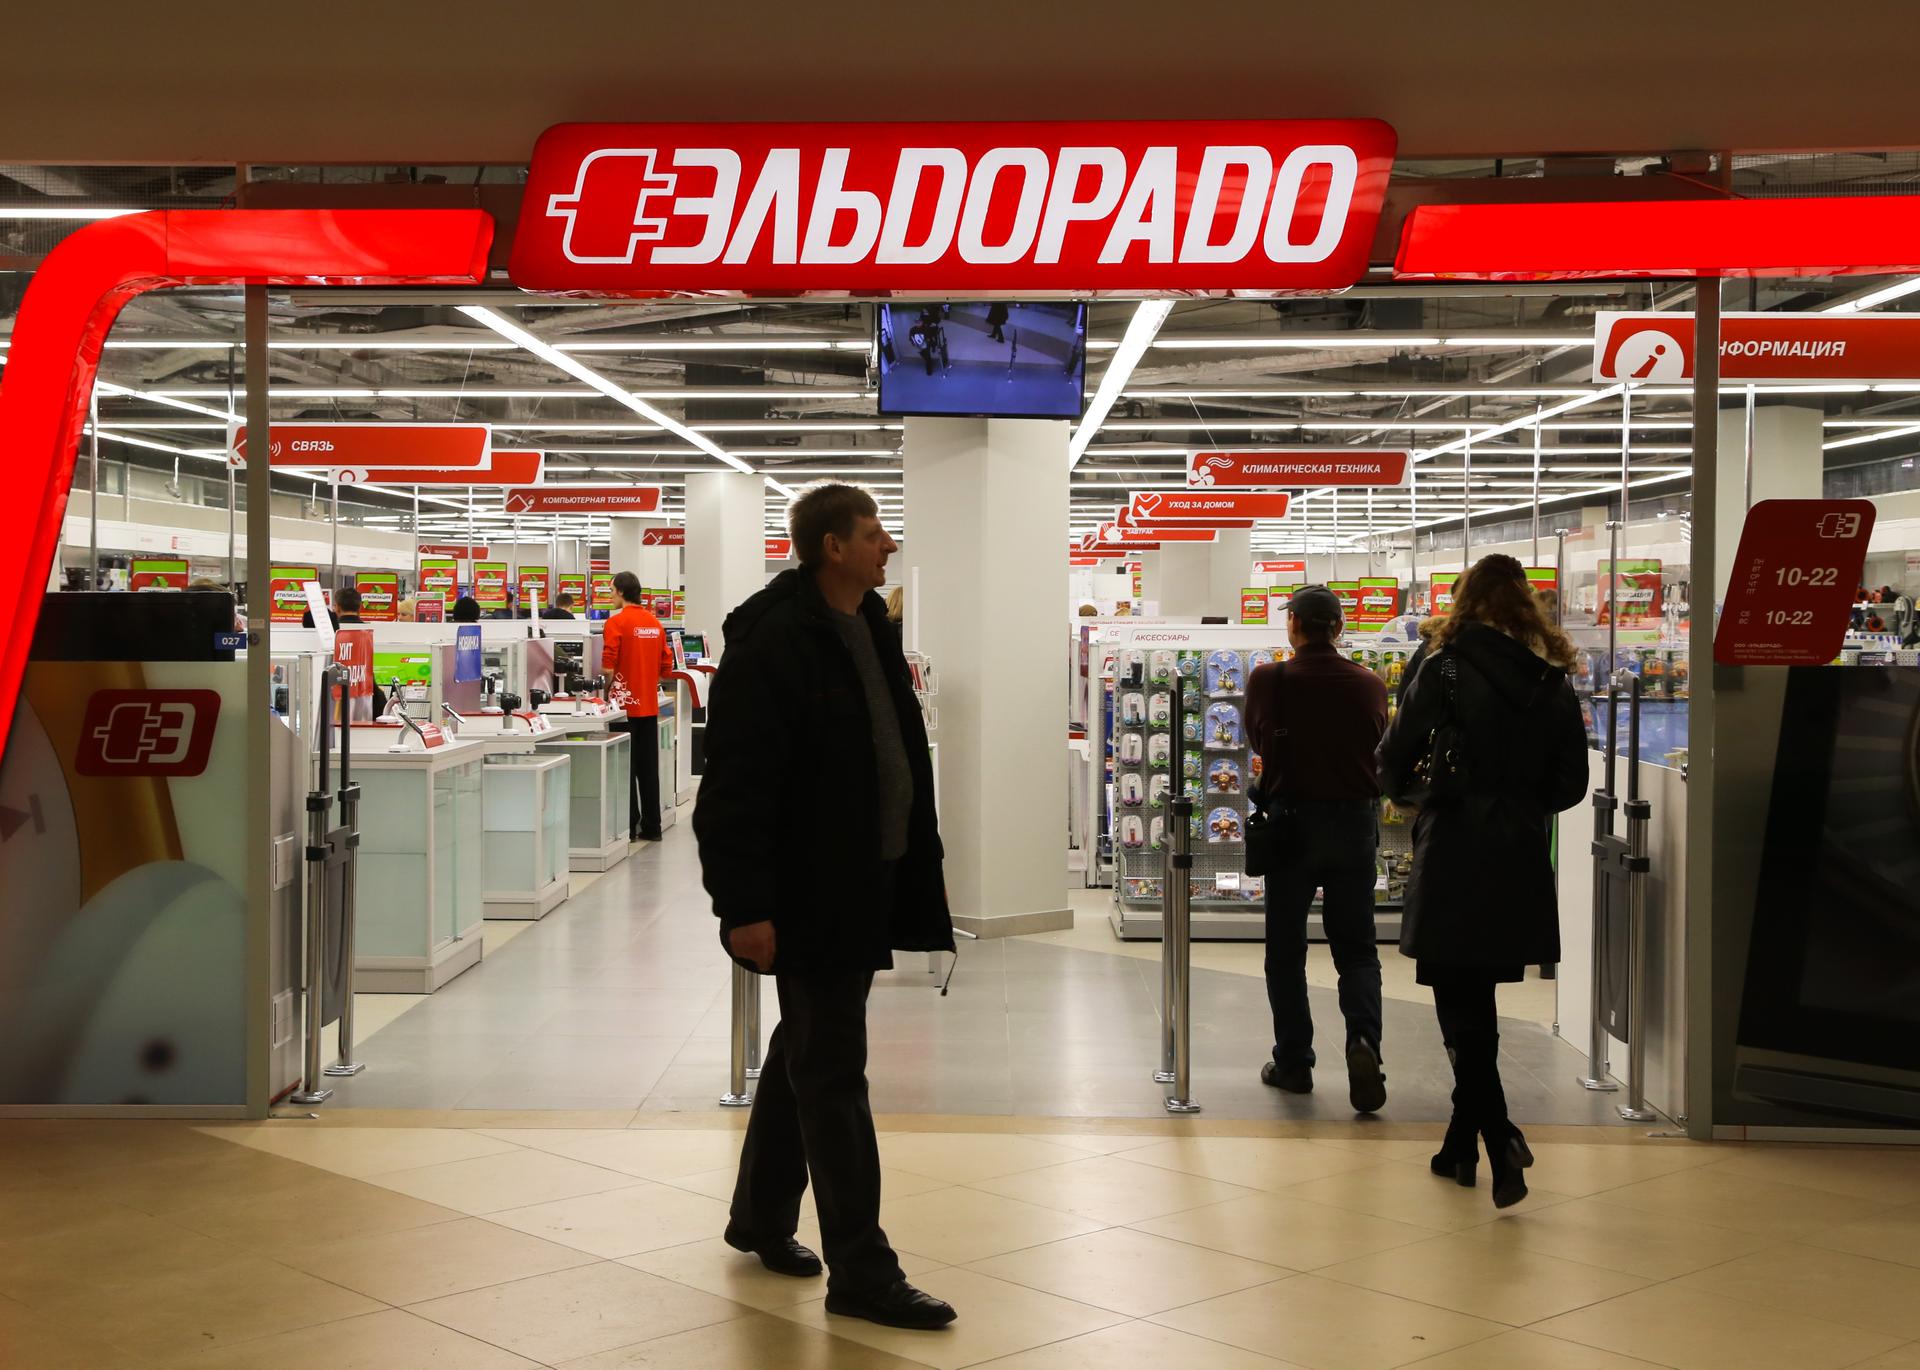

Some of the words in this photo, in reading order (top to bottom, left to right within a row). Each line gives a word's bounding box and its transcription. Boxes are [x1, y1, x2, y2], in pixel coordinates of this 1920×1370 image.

[1719, 340, 1846, 359] НФОРМАЦИЯ
[291, 440, 335, 451] СВЯЗЬ
[1242, 464, 1333, 474] КЛИМАТИЧЕСКАЯ
[1335, 464, 1381, 473] ТЕХНИКА
[543, 496, 606, 504] КОМПЬЮТЕРНАЯ
[1168, 501, 1190, 509] УХОД
[1203, 501, 1235, 509] ДОМОМ
[1776, 567, 1838, 586] 10-22
[1766, 610, 1814, 625] 10-22
[221, 637, 240, 645] 027
[457, 635, 480, 651] НОВИНКА
[338, 642, 353, 661] ХИТ
